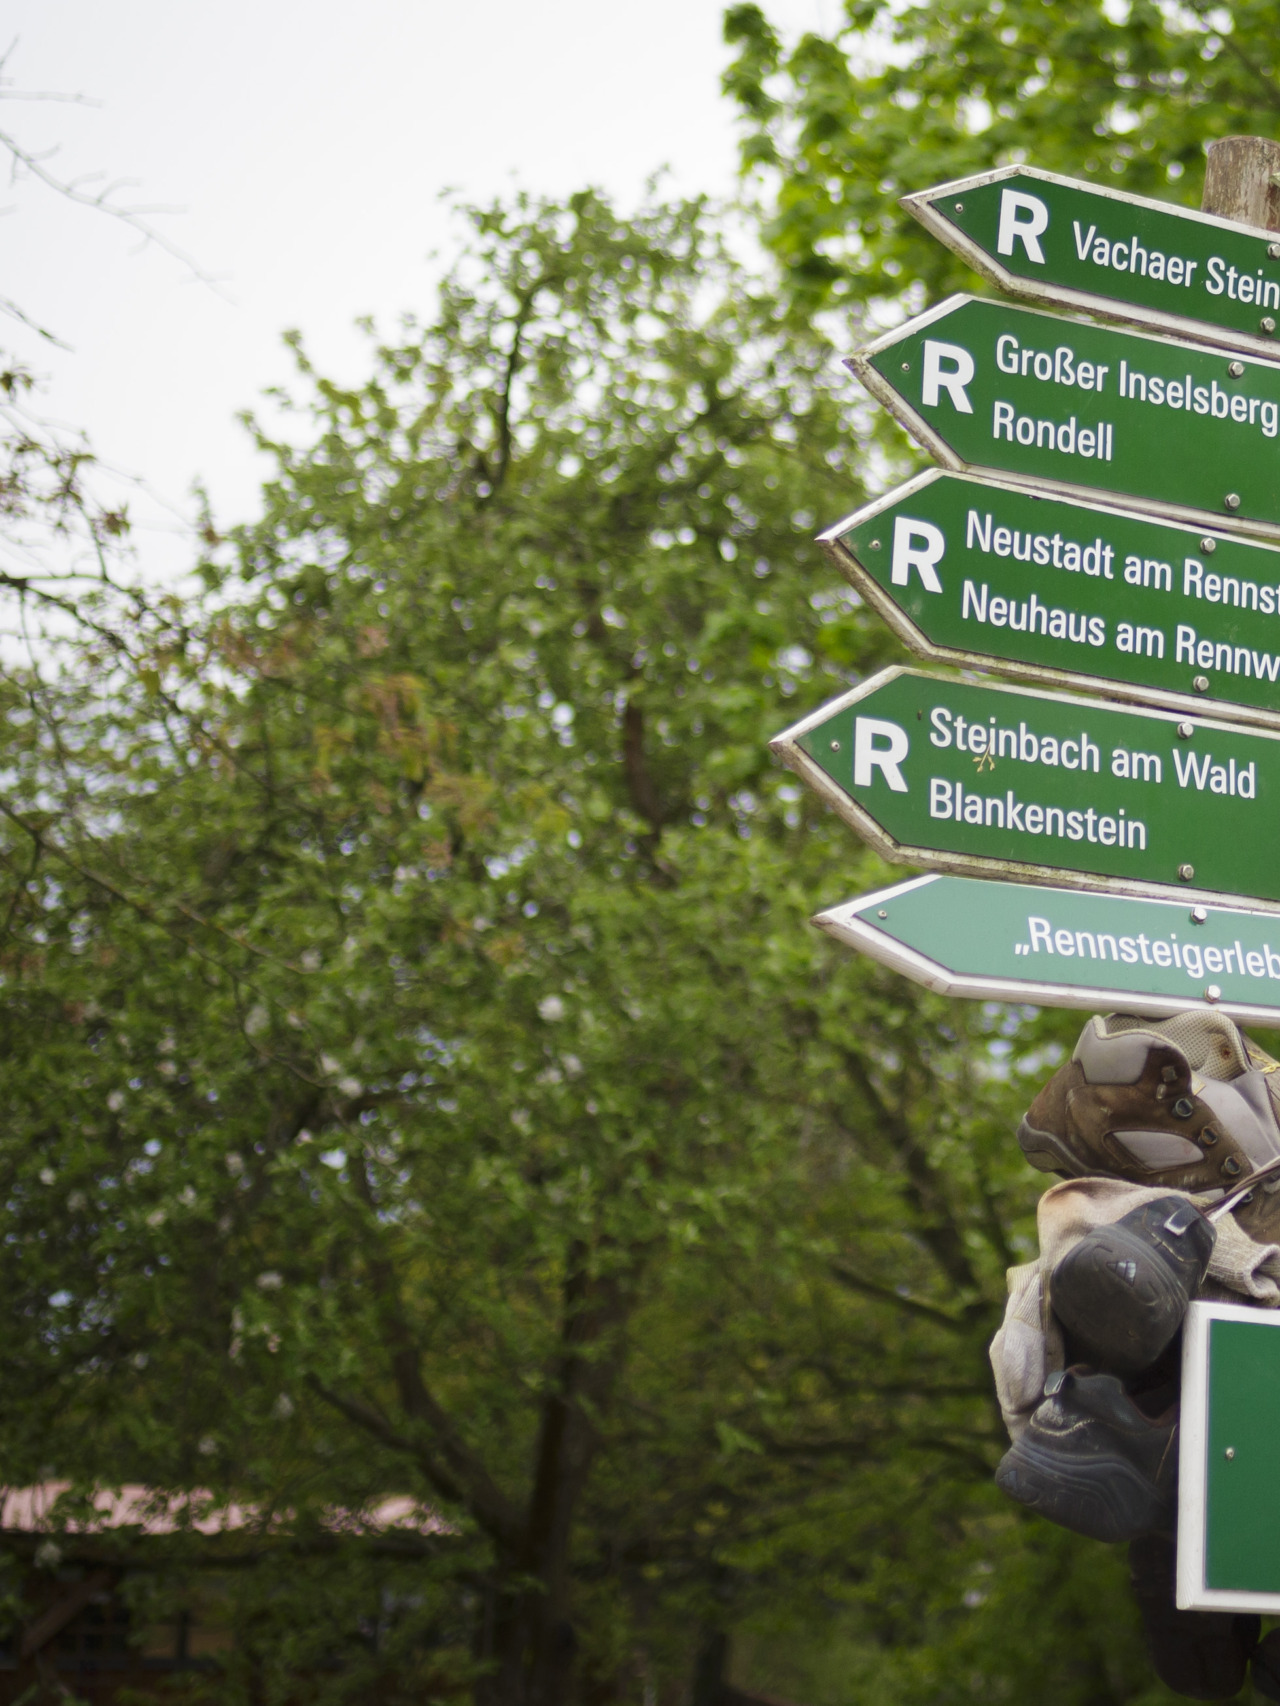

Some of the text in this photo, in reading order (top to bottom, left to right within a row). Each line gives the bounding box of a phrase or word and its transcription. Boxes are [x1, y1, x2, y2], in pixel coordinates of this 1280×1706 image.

[997, 188, 1049, 265] R
[1073, 220, 1197, 288] Vachaer
[1205, 256, 1280, 310] Stein
[921, 340, 975, 414] R
[997, 335, 1108, 391] Großer
[1119, 361, 1279, 437] Inselsberg
[994, 401, 1112, 460] Rondell
[892, 517, 944, 593] R
[965, 509, 1114, 578] Neustadt
[1124, 556, 1171, 591] am
[962, 579, 1105, 647] Neuhaus
[1116, 624, 1164, 658] am
[855, 717, 908, 792] R
[929, 708, 1100, 774] Steinbach
[1112, 749, 1161, 783] am
[1173, 749, 1255, 798] Wald
[929, 779, 1147, 851] Blankenstein
